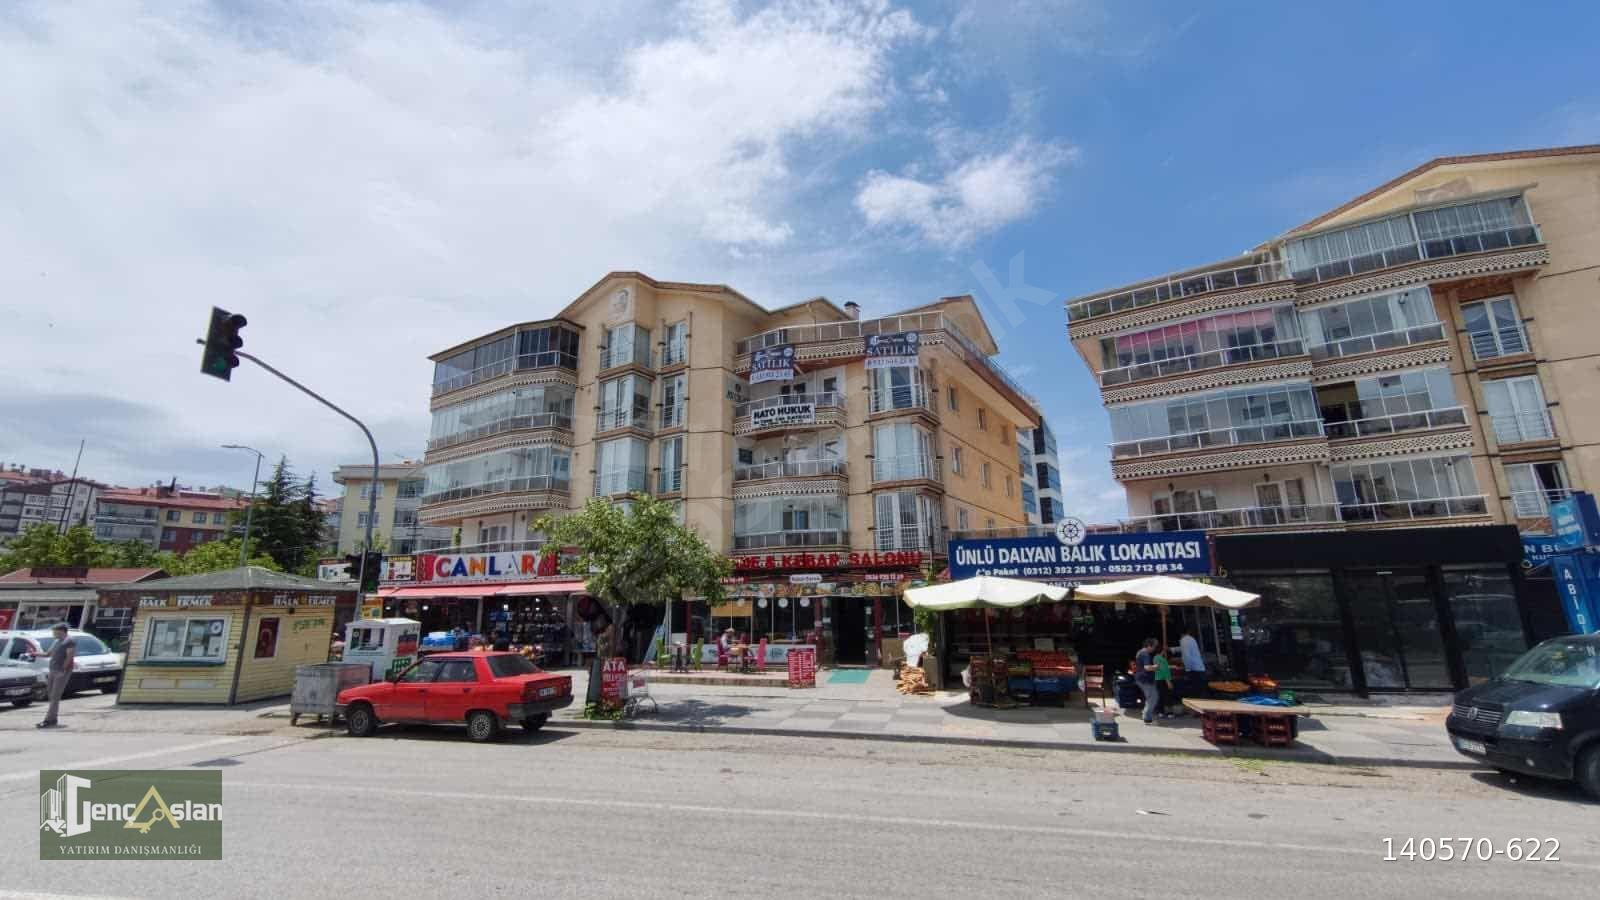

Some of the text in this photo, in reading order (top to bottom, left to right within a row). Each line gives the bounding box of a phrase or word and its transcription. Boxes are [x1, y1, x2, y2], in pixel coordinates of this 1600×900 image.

[753, 409, 776, 420] NATO
[777, 405, 811, 416] HUKUK
[849, 551, 922, 568] SALONU
[956, 541, 1201, 566] ÜNLÜ DALYAN BALIK LOKANTASI
[602, 660, 625, 673] ATA
